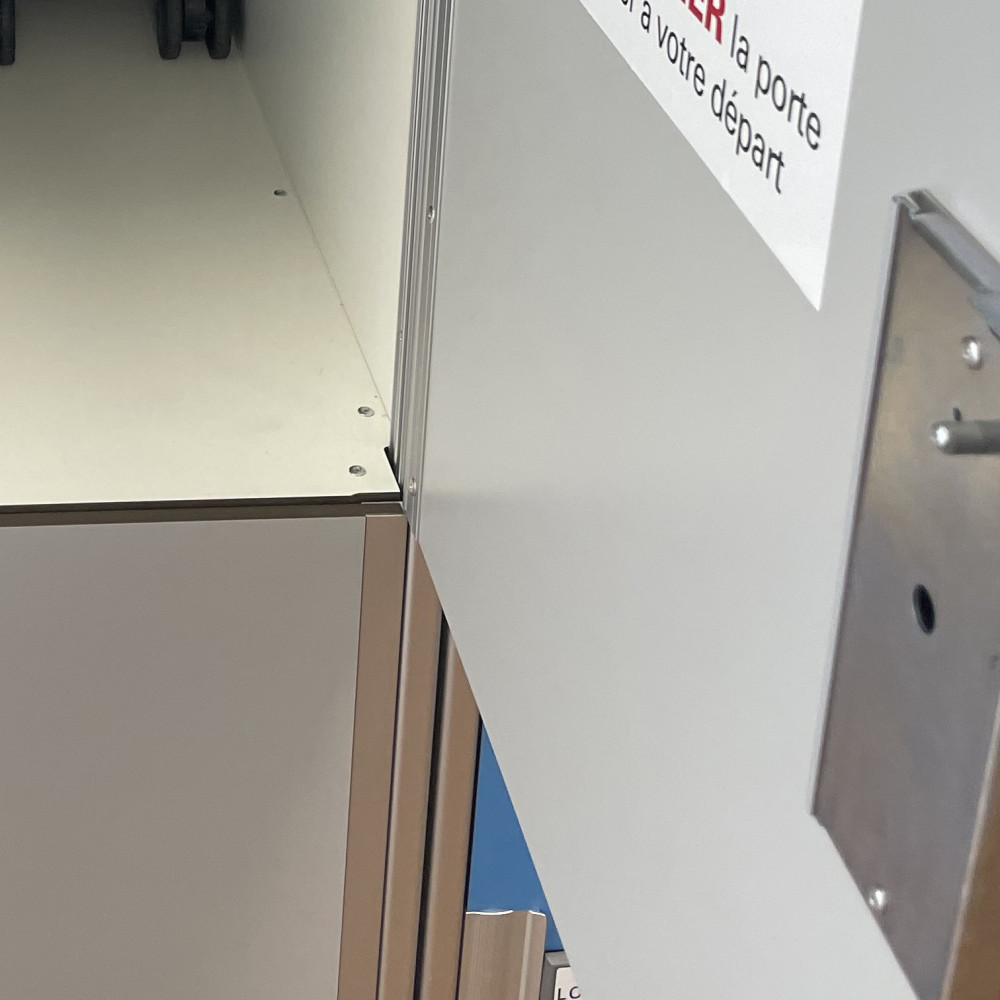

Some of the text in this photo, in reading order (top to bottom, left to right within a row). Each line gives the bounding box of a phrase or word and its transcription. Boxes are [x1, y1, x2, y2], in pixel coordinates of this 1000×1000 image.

[657, 15, 706, 97] votre
[710, 79, 785, 195] départ
[730, 13, 750, 73] la
[754, 55, 821, 151] porte
